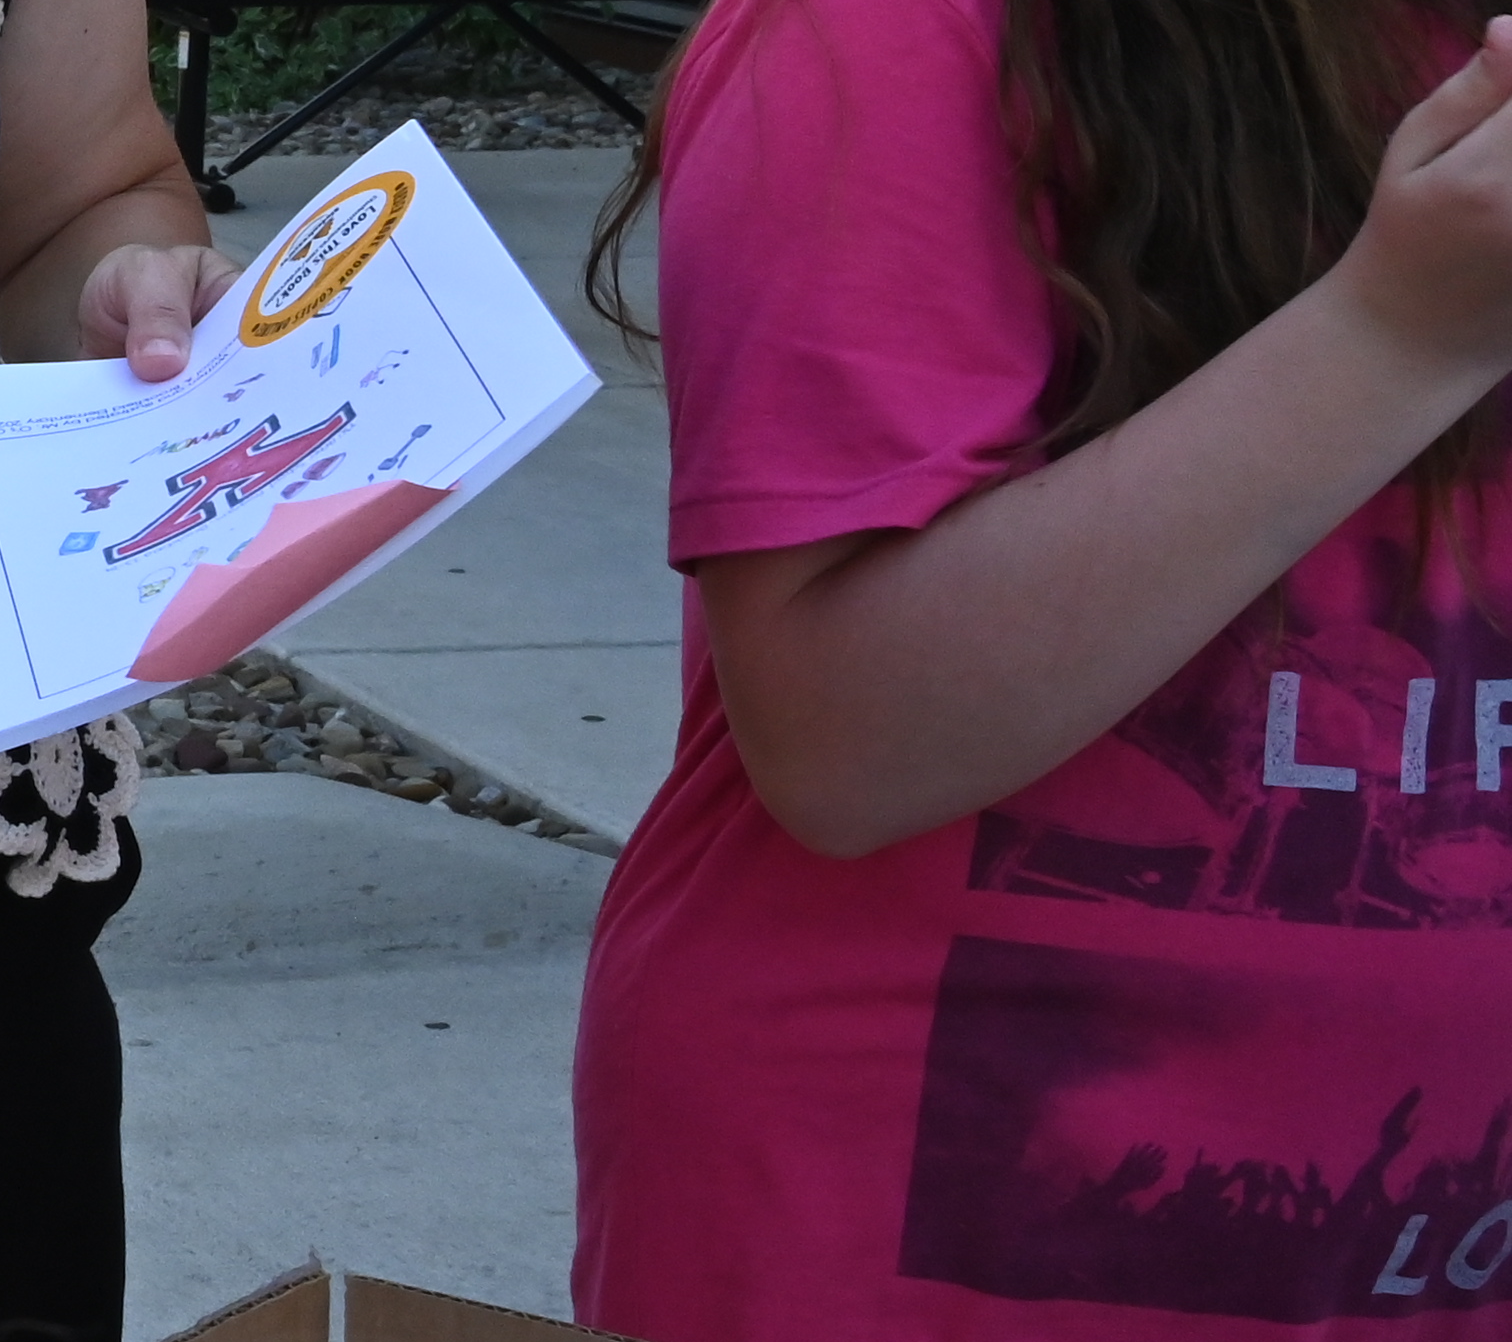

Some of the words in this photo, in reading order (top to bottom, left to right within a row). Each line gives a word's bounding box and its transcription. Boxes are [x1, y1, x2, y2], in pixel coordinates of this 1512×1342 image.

[341, 205, 378, 237] Love
[312, 239, 341, 265] This
[337, 252, 371, 286] BOOK
[275, 267, 313, 309] Book?
